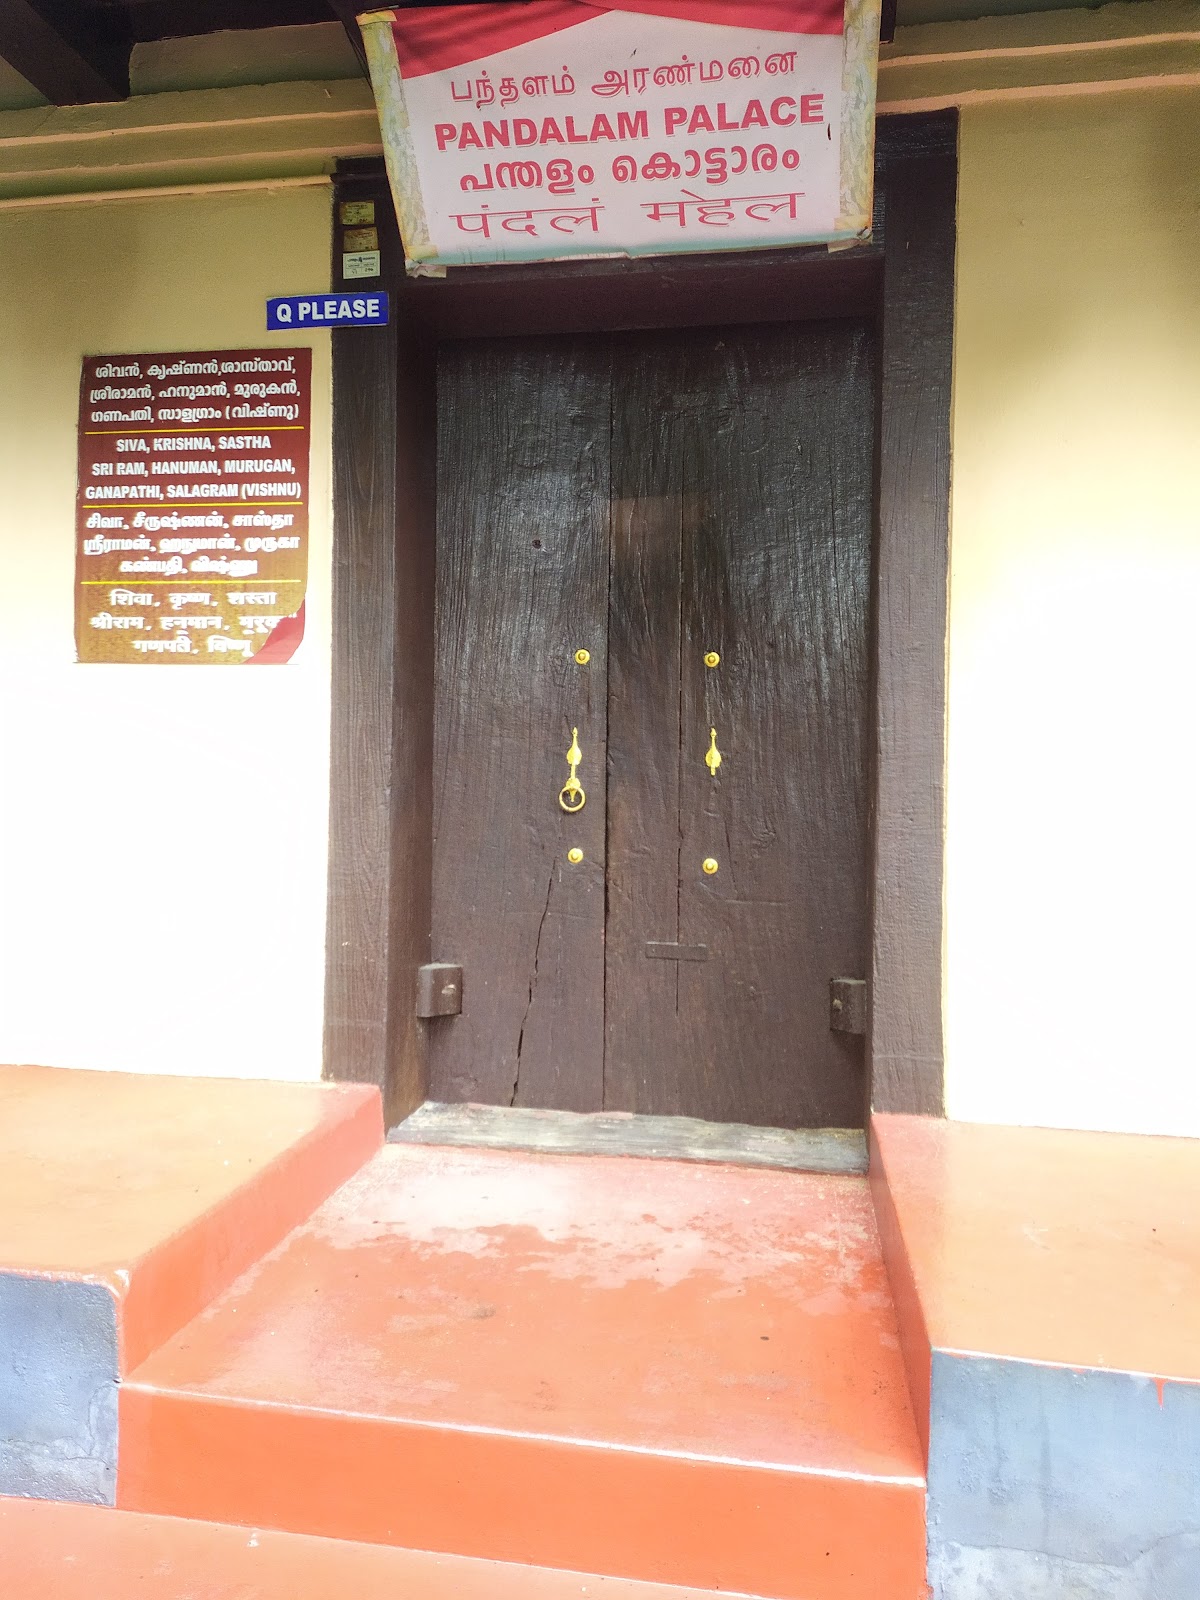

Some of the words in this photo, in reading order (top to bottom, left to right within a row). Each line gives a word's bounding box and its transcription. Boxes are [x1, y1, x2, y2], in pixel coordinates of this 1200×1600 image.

[451, 65, 577, 108] பந்தளம்
[590, 50, 798, 97] அரண்மனை
[434, 109, 651, 151] PANDALAM
[664, 93, 825, 137] PALACE
[459, 157, 596, 195] പന്തളം
[611, 142, 801, 185] കൊട്ടാരം
[449, 197, 606, 240] पंदलं
[640, 188, 806, 229] महेल
[276, 303, 292, 323] Q
[298, 299, 380, 321] PLEASE
[95, 362, 144, 380] ശിവൻ,
[89, 384, 155, 404] ശ്രീരാമൻ,
[158, 381, 231, 399] ഹനുമാൻ,
[234, 379, 301, 398] മുരുകൻ,
[91, 405, 155, 424] ഗണപതി,
[116, 439, 151, 454] SIVA,
[153, 437, 216, 453] KRISHNA,
[218, 435, 271, 450] SASTHA
[92, 463, 114, 476] SRI
[116, 462, 149, 477] RAM,
[151, 460, 222, 477] HANUMAN,
[224, 458, 296, 475] MURUGAN,
[85, 485, 164, 500] GANAPATHI,
[166, 484, 239, 499] SALAGRAM
[241, 482, 302, 499] (VISHNU)
